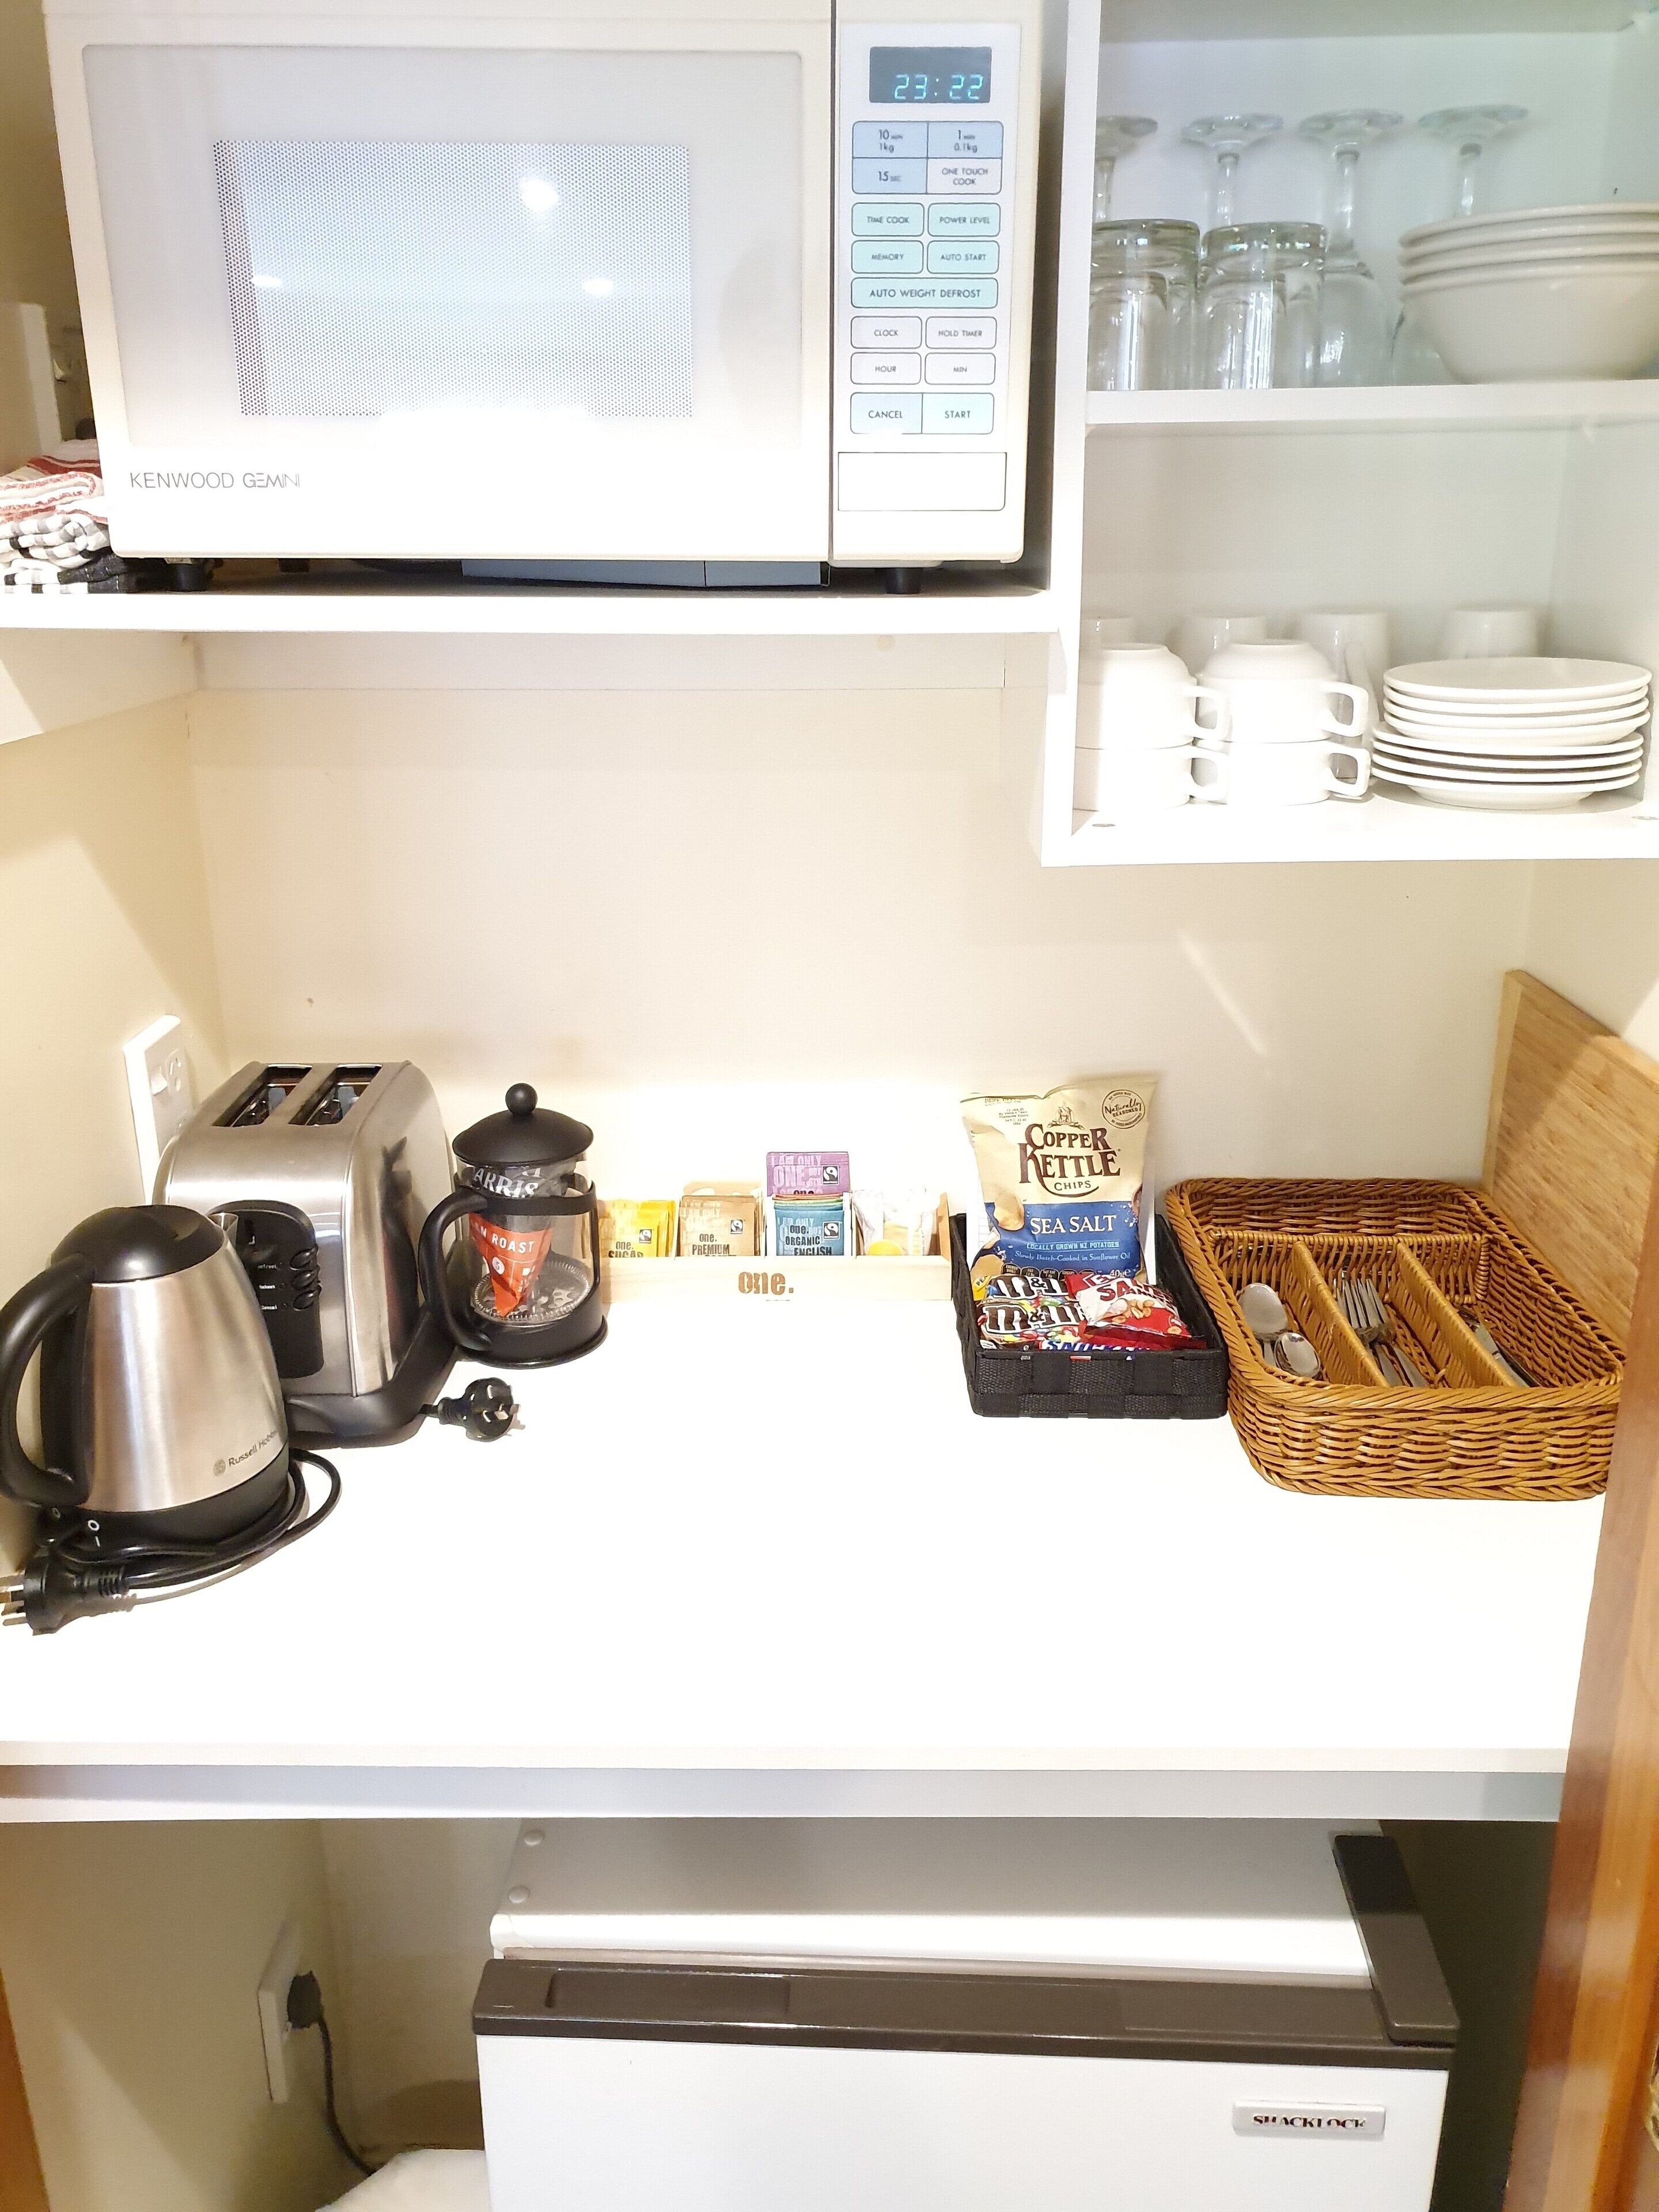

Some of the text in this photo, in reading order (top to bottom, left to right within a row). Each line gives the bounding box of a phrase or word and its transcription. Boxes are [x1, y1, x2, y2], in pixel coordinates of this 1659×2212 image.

[894, 74, 983, 100] 23:22
[878, 129, 889, 140] 10
[957, 130, 961, 140] 1
[878, 171, 889, 181] 15
[941, 168, 988, 176] ONE TOUCH
[953, 177, 976, 185] COOK
[867, 216, 910, 224] TIME COOK
[869, 289, 980, 298] AUTO WEIGHT DEFROST
[874, 329, 899, 337] CLOCK
[938, 329, 983, 338] HOLD TIMER
[875, 365, 897, 373] HOUR
[868, 410, 903, 419] CANCEL
[944, 410, 971, 419] START
[130, 472, 300, 488] KENWOOD GEMINI
[1025, 1123, 1112, 1151] COPPER
[1017, 1143, 1121, 1184] KETTLE
[1054, 1180, 1092, 1191] CHIPS
[790, 1224, 809, 1234] one.
[1029, 1214, 1117, 1235] SEA SALT
[699, 1233, 718, 1243] one.
[785, 1236, 820, 1247] ORGANIC
[491, 1233, 535, 1254] ROAST
[616, 1241, 634, 1251] one.
[1027, 1242, 1053, 1251] LOCALLY
[1090, 1241, 1119, 1249] POTATOES
[692, 1244, 730, 1255] PREMIUM
[1014, 1251, 1035, 1260] Slowly
[1089, 1252, 1119, 1262] Sunflower
[738, 1271, 794, 1296] one.
[228, 1444, 257, 1467] Russell
[1252, 2115, 1367, 2128] SHACKLOCK
